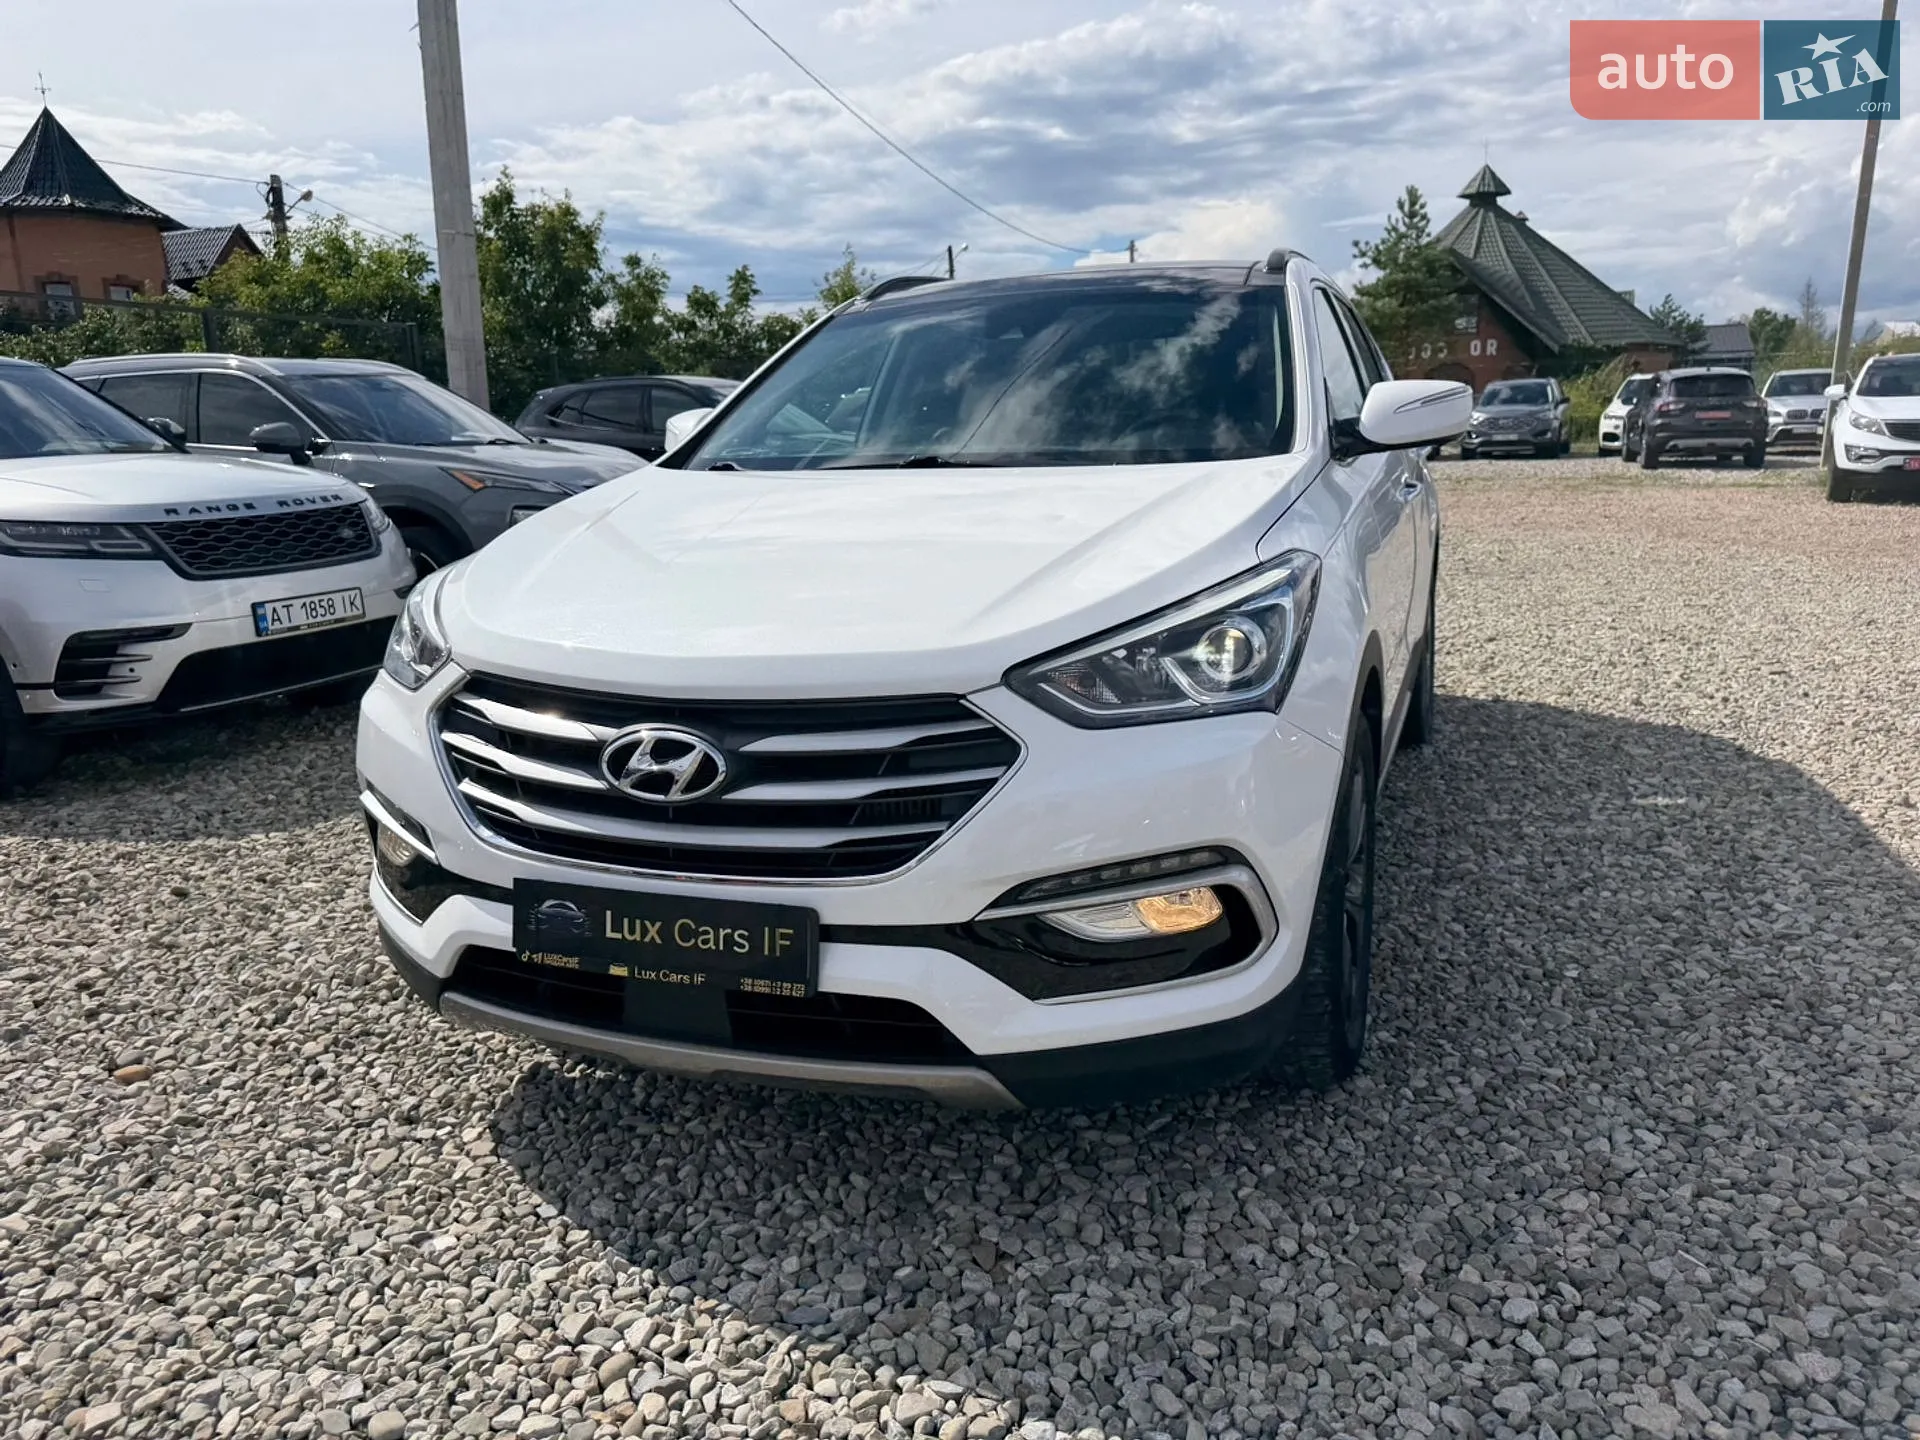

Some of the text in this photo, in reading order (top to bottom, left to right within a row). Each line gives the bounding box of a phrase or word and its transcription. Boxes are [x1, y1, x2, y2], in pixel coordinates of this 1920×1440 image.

[163, 494, 343, 516] RANGE ROVER
[270, 604, 294, 626] AT
[300, 597, 336, 620] 1858
[341, 593, 360, 613] IK
[605, 909, 794, 956] Lux Cars IF
[634, 966, 706, 985] Lux Cars IF
